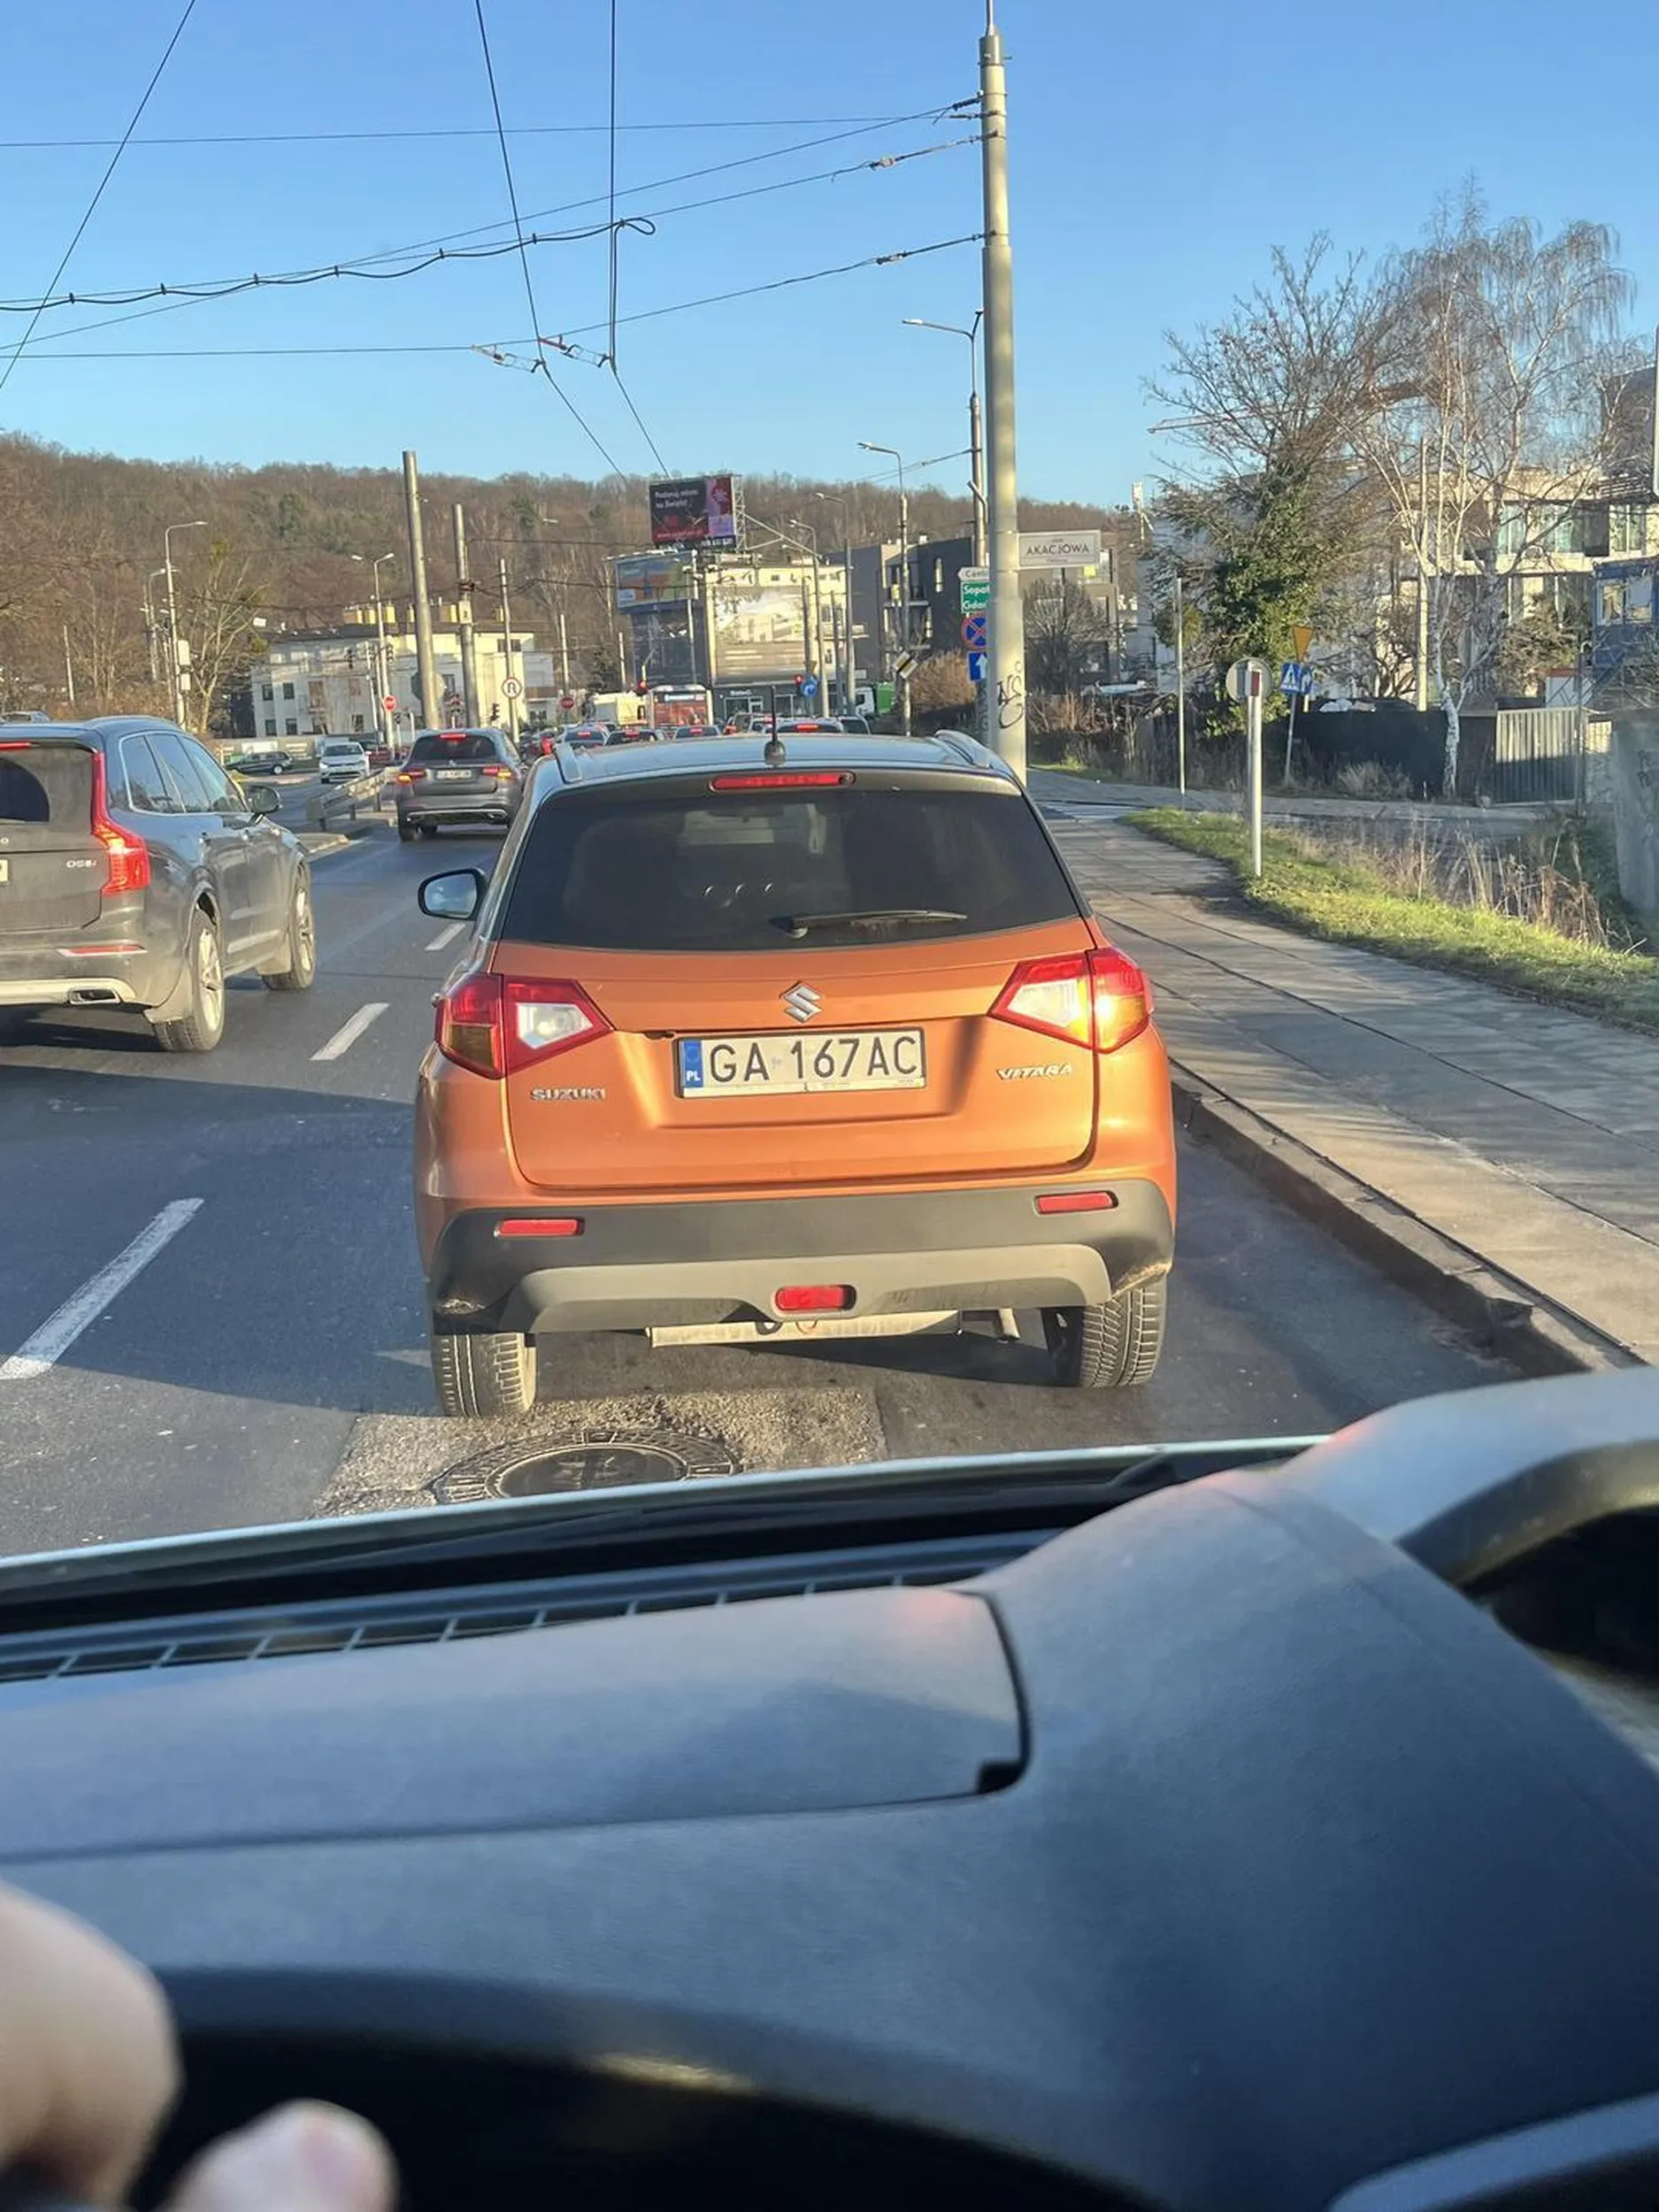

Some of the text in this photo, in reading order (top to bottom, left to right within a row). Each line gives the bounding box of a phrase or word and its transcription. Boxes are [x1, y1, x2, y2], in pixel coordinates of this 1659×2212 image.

[1026, 543, 1089, 555] AKACJOWA
[710, 1036, 918, 1083] GA 167AC
[686, 1071, 702, 1081] PL
[995, 1063, 1072, 1080] VITARA
[530, 1087, 606, 1101] SUZUKI
